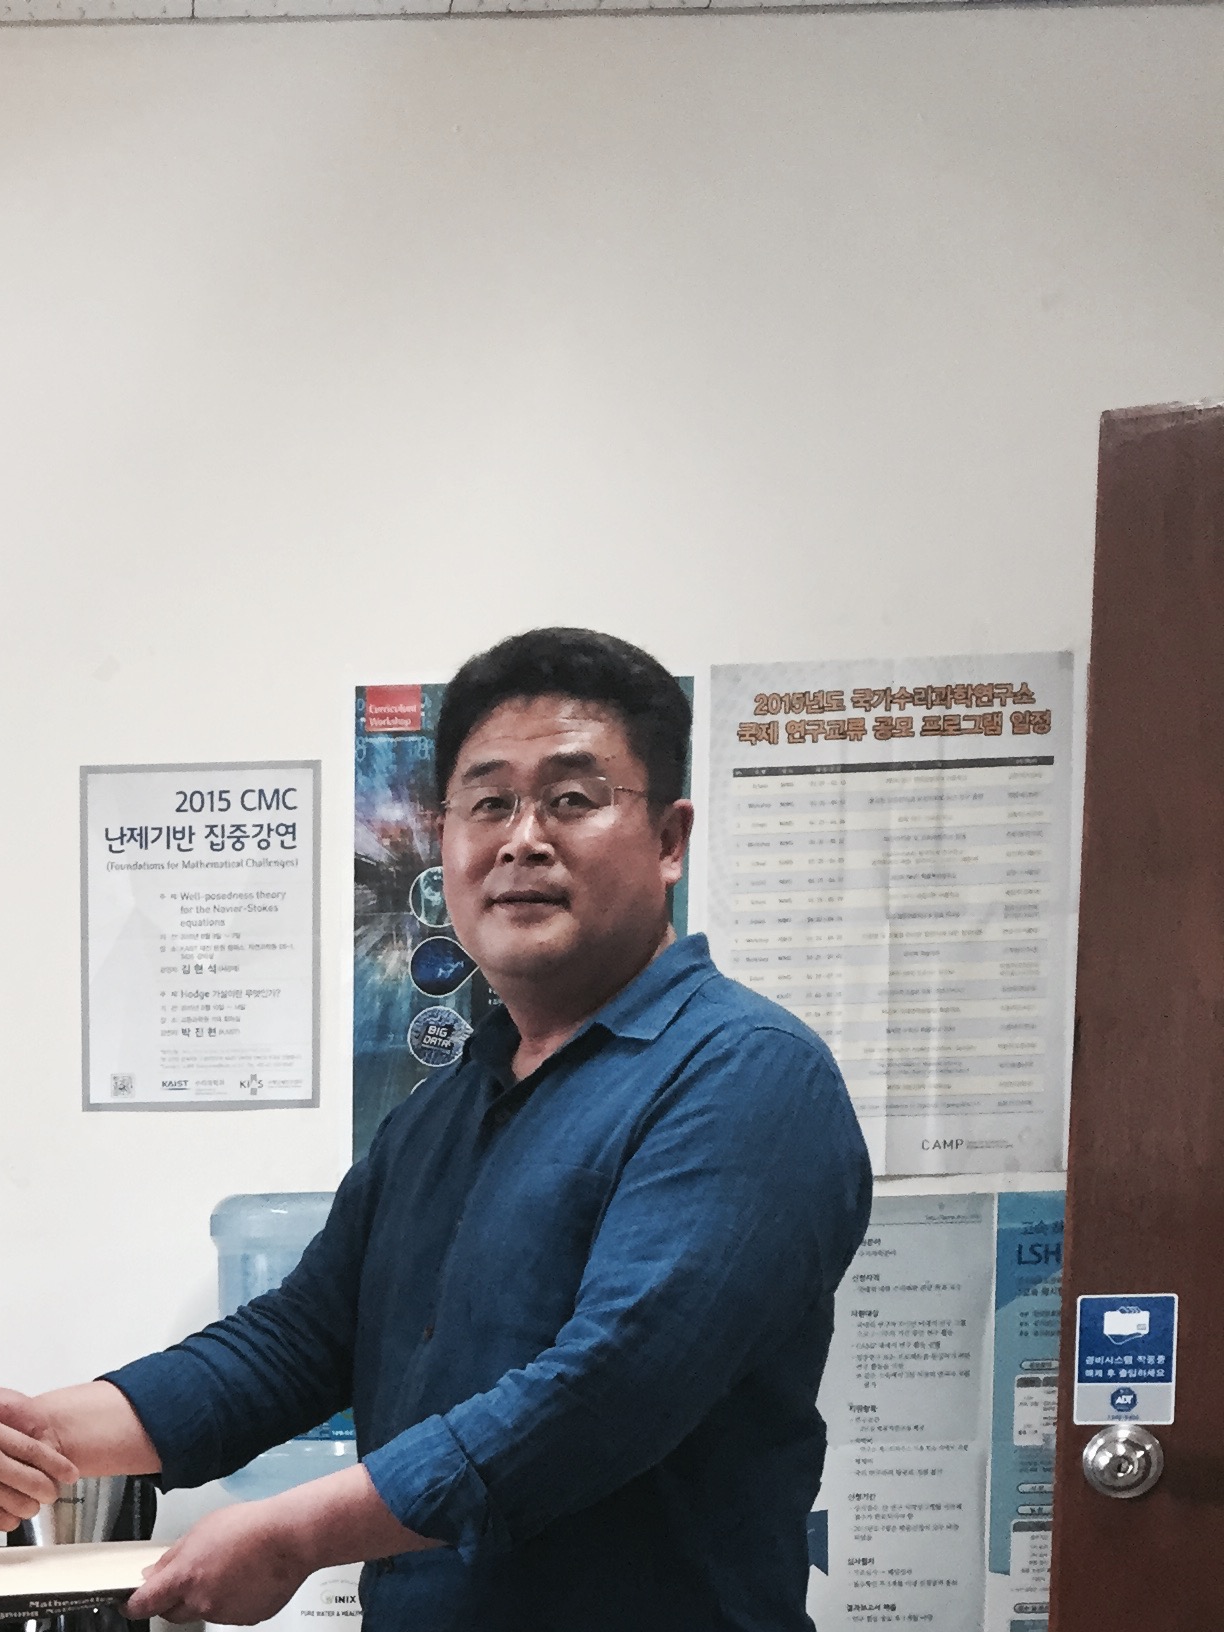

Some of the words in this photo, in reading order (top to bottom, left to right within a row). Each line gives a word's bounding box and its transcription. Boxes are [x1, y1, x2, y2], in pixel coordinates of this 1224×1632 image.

[754, 691, 846, 715] 2015년도
[851, 682, 1036, 712] 국가수리과학연구소
[369, 717, 411, 726] Workshop
[737, 721, 779, 745] 국제
[785, 716, 867, 744] 연구교류
[872, 716, 915, 740] 공모
[920, 711, 1003, 737] 프로그램
[1009, 709, 1052, 735] 일정
[175, 790, 231, 813] 2015
[240, 787, 298, 811] CMC
[105, 825, 195, 853] 난제기반
[204, 822, 297, 852] 집중강연
[106, 861, 165, 871] (Foundations
[167, 860, 178, 870] for
[181, 859, 243, 870] Mathematical
[245, 858, 299, 869] Challenges)
[256, 891, 286, 901] theory
[180, 905, 193, 914] for
[195, 905, 211, 914] the
[180, 919, 225, 928] equations
[180, 990, 210, 1000] Hodge
[428, 1025, 448, 1037] BIG
[423, 1035, 451, 1048] DATA
[161, 1080, 189, 1088] KAIST
[921, 1139, 964, 1150] CAMP
[1017, 1243, 1062, 1265] LSH
[1116, 1395, 1134, 1404] ADT
